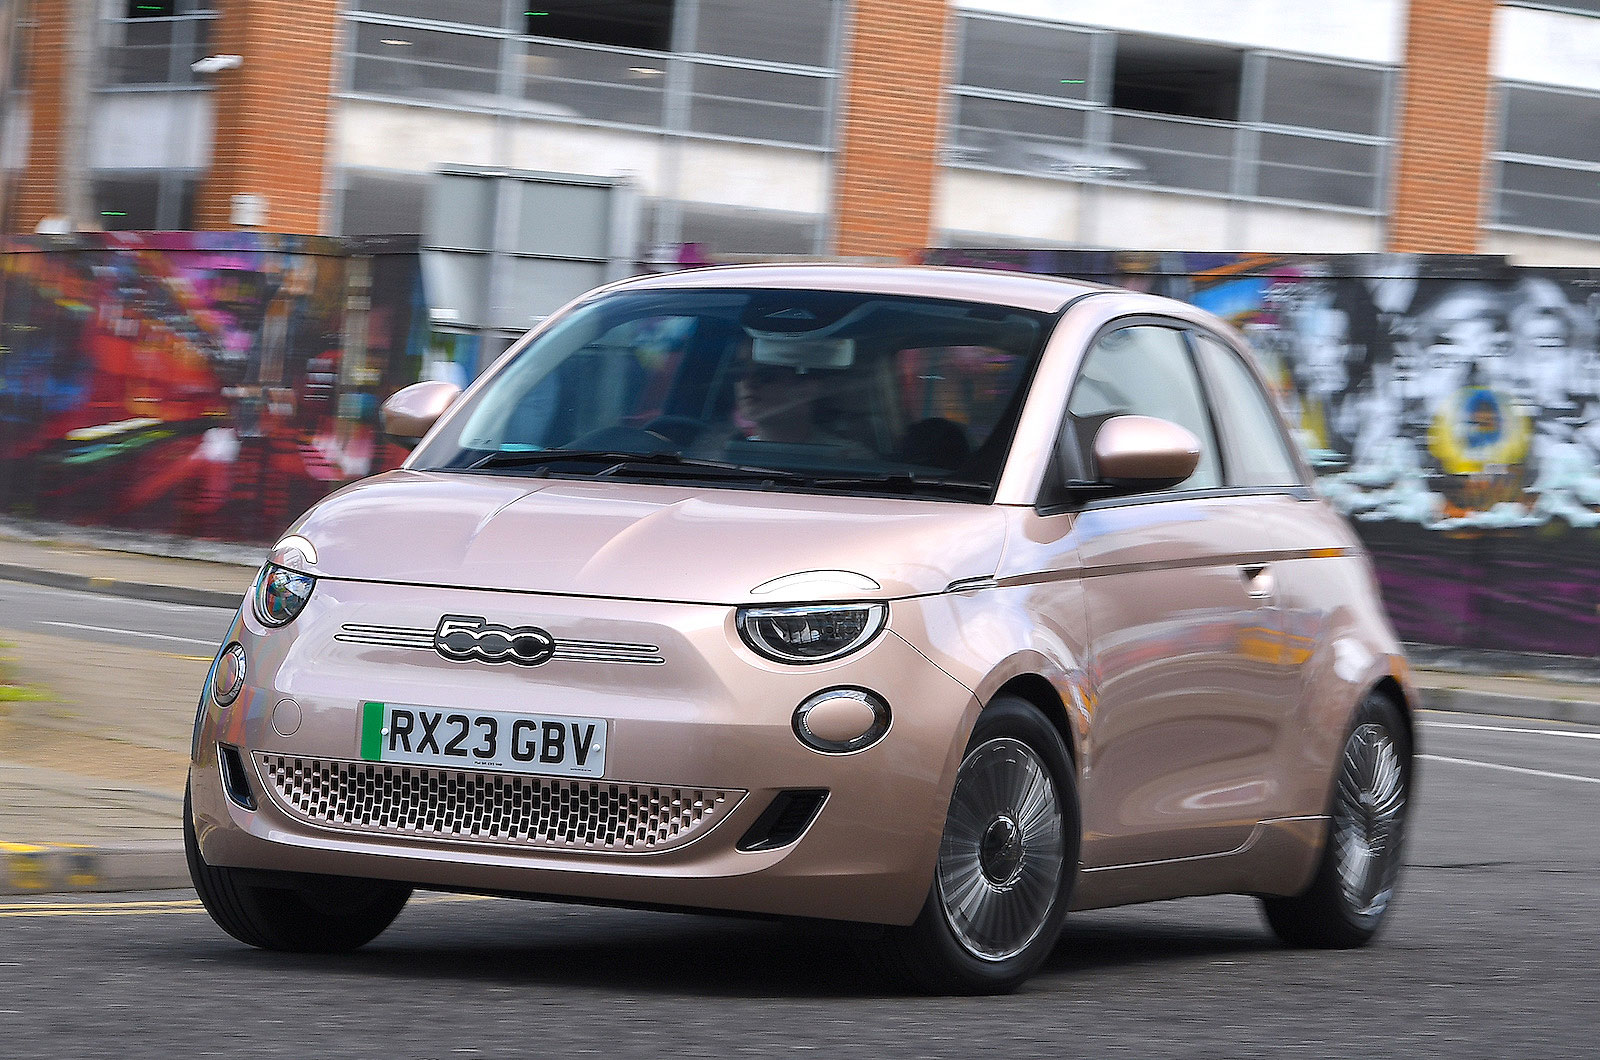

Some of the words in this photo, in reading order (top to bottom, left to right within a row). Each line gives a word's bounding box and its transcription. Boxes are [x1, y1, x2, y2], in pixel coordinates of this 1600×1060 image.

[436, 617, 551, 662] 500
[388, 709, 498, 759] RX23
[511, 719, 596, 766] GBV
